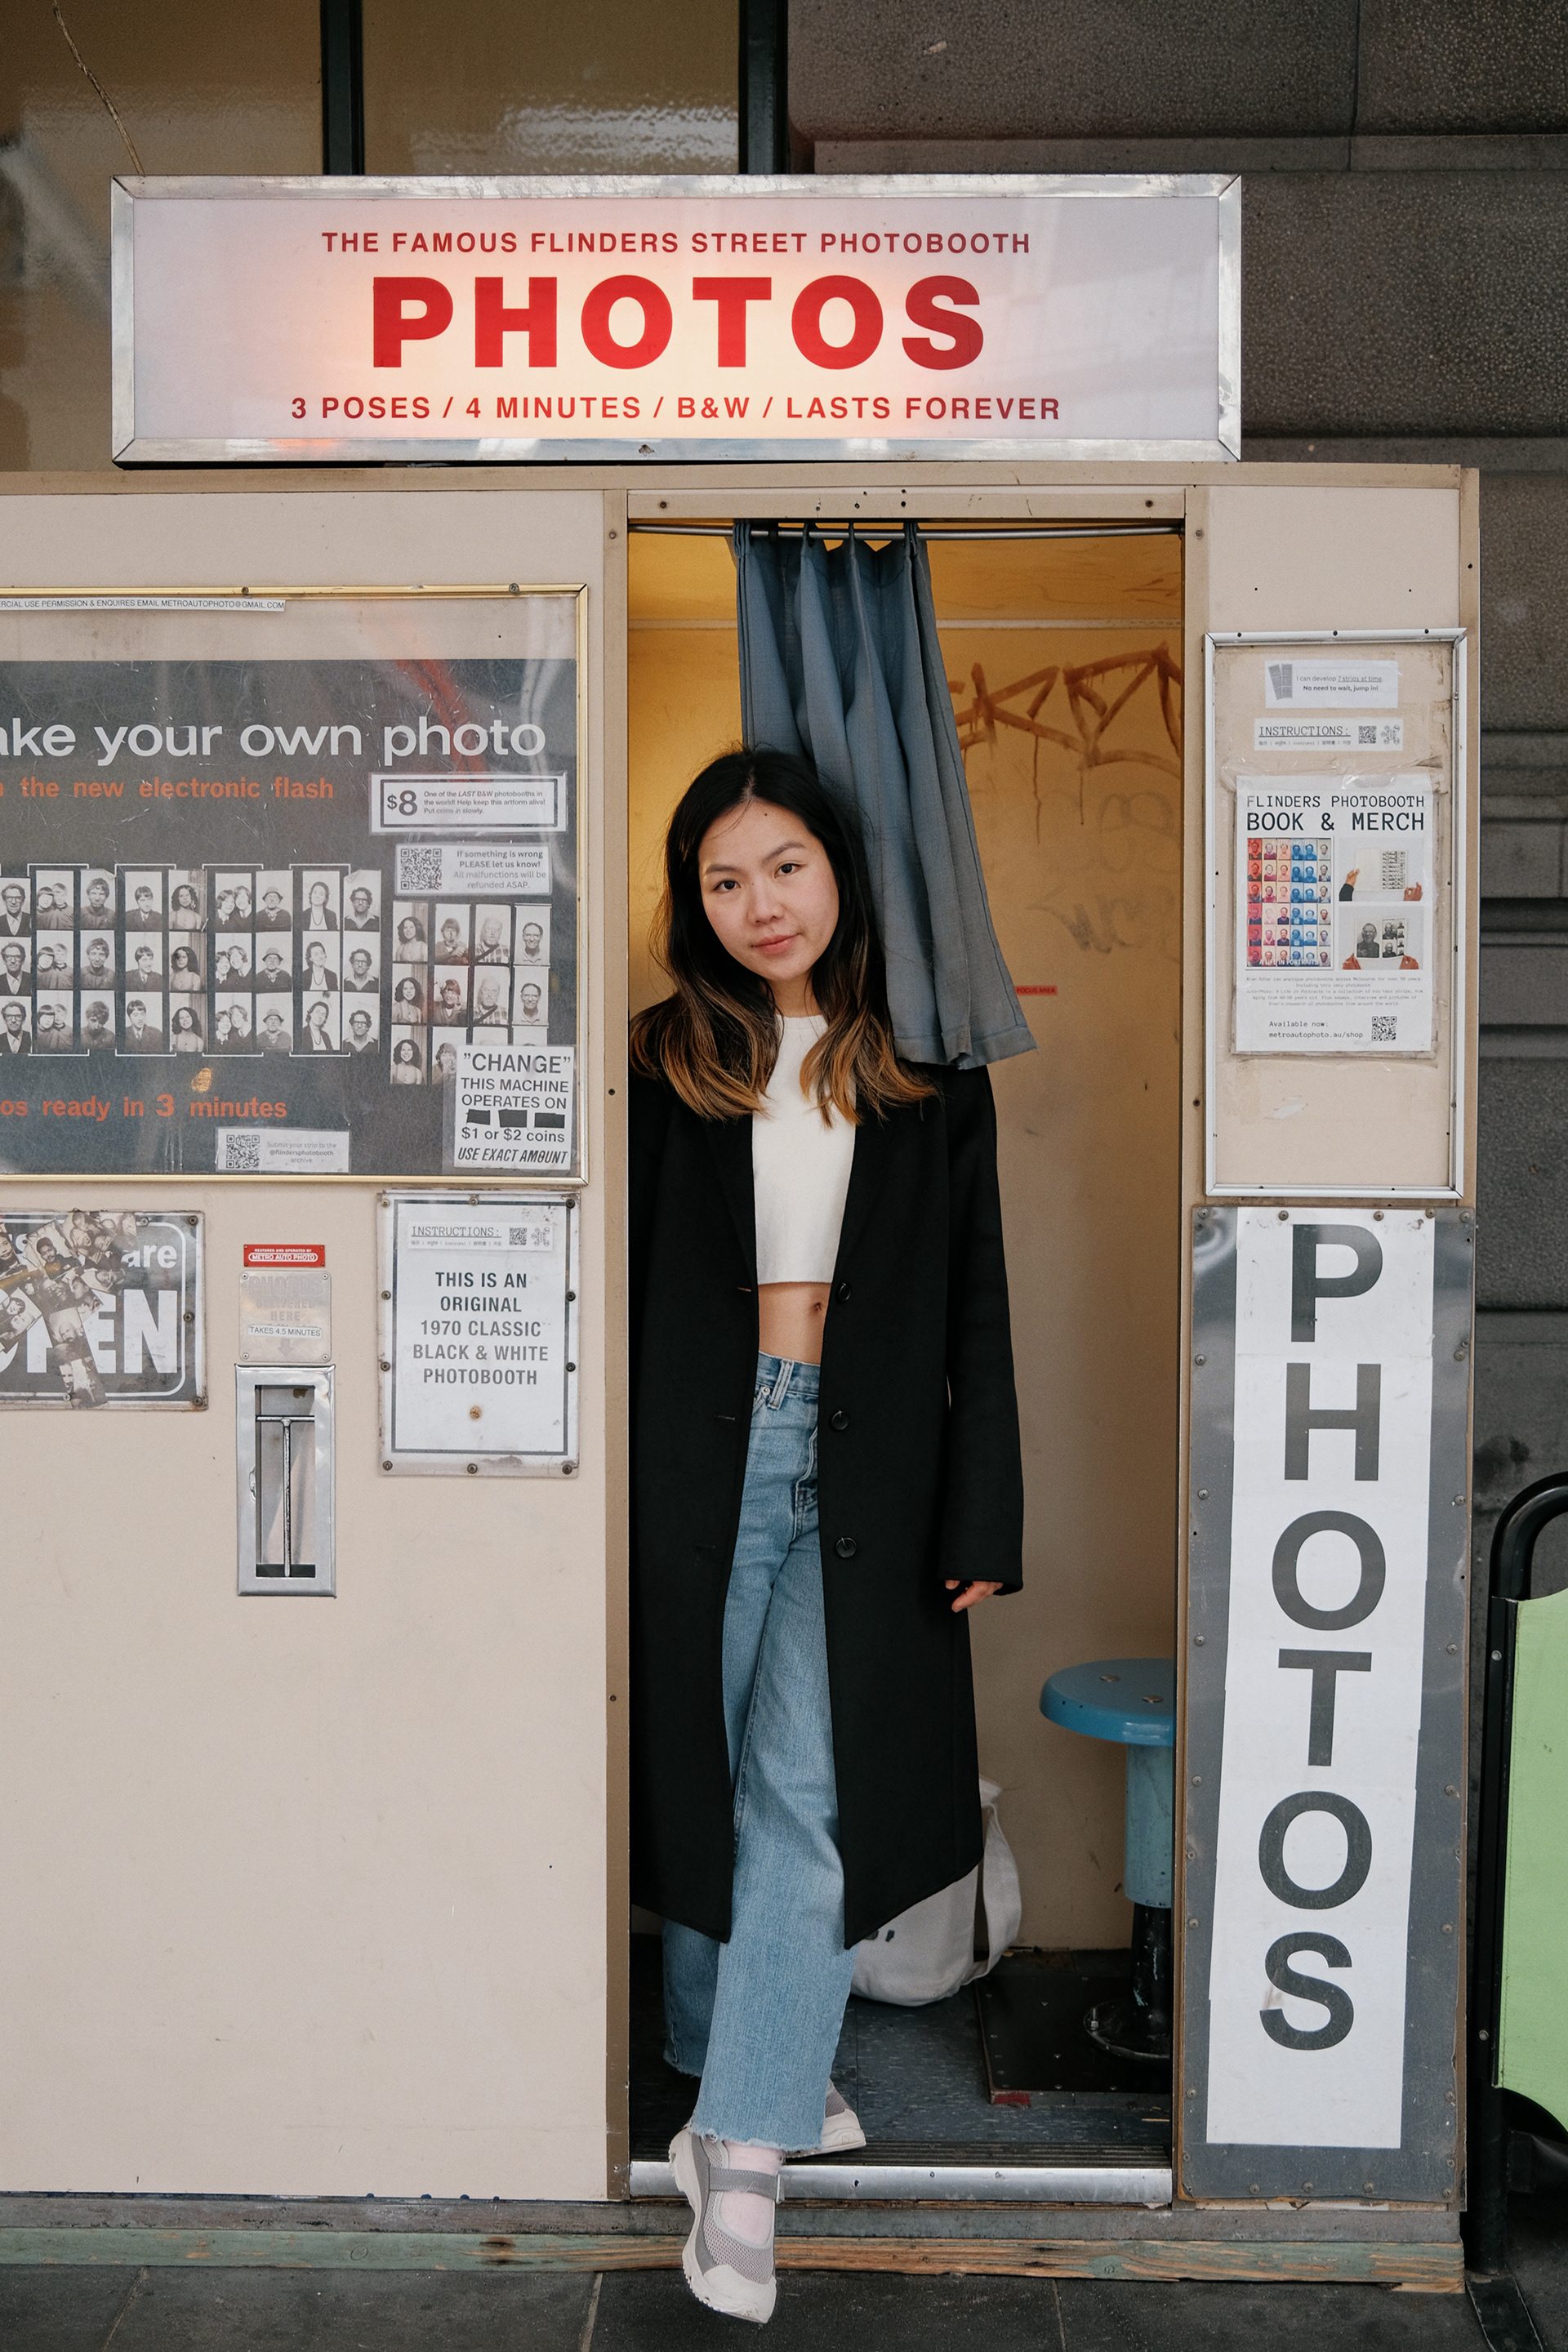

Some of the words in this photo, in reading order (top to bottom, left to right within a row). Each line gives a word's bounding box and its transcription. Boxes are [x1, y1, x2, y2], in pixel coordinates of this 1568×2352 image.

[322, 233, 378, 252] THE
[393, 233, 516, 252] FAMOUS
[532, 233, 678, 252] FLINDERS
[693, 233, 807, 252] STREET
[822, 233, 1029, 253] PHOTOBOOTH
[373, 275, 983, 370] PHOTOS
[292, 398, 306, 418] 3
[323, 397, 430, 418] POSES
[466, 398, 480, 418] 4
[497, 397, 639, 418] MINUTES
[679, 397, 749, 418] B&W
[788, 397, 889, 419] LASTS
[906, 397, 1059, 419] FOREVER
[161, 599, 284, 608] METROAUTOPHOTO@GMAIL.COM
[1258, 726, 1351, 737] INSTRUCTIONS:
[0, 718, 77, 756] ke
[94, 724, 222, 766] your
[240, 724, 362, 756] own
[384, 717, 546, 766] photo
[20, 776, 60, 797] the
[74, 782, 124, 797] new
[139, 777, 260, 798] electronic
[274, 776, 334, 799] flash
[387, 790, 418, 816] $8
[1247, 795, 1321, 808] FLINDERS
[1331, 795, 1424, 808] PHOTOBOOTH
[1247, 813, 1304, 831] BOOK
[1321, 813, 1334, 831] &
[1352, 813, 1424, 831] MERCH
[465, 850, 508, 859] something
[453, 871, 464, 879] All
[466, 871, 519, 879] malfunctions
[520, 871, 534, 879] will
[536, 871, 546, 879] be
[1269, 1031, 1364, 1040] metroautophoto.au/shop
[461, 1077, 495, 1090] THIS
[500, 1079, 569, 1093] MACHINE
[42, 1095, 111, 1122] ready
[123, 1096, 145, 1117] in
[156, 1095, 175, 1117] 3
[190, 1096, 287, 1118] minutes
[461, 1094, 540, 1108] OPERATES
[545, 1098, 567, 1109] ON
[461, 1126, 479, 1140] $1
[484, 1130, 499, 1140] or
[503, 1127, 522, 1142] $2
[527, 1130, 565, 1143] coins
[458, 1147, 480, 1160] USE
[482, 1148, 519, 1162] EXACT
[519, 1150, 568, 1164] AMOUNT
[412, 1226, 501, 1237] INSTRUCTIONS:
[435, 1272, 474, 1287] THIS
[481, 1272, 497, 1287] IS
[504, 1273, 527, 1288] AN
[440, 1296, 522, 1312] ORIGINAL
[270, 1311, 301, 1321] HERE
[250, 1326, 274, 1334] TAKES
[287, 1329, 321, 1337] MINUTES
[421, 1320, 461, 1335] 1970
[468, 1321, 541, 1337] CLASSIC
[413, 1344, 470, 1360] BLACK
[475, 1345, 488, 1360] &
[494, 1345, 548, 1361] WHITE
[423, 1368, 537, 1385] PHOTOBOOTH
[1258, 1224, 1386, 2051] PHOTOS
